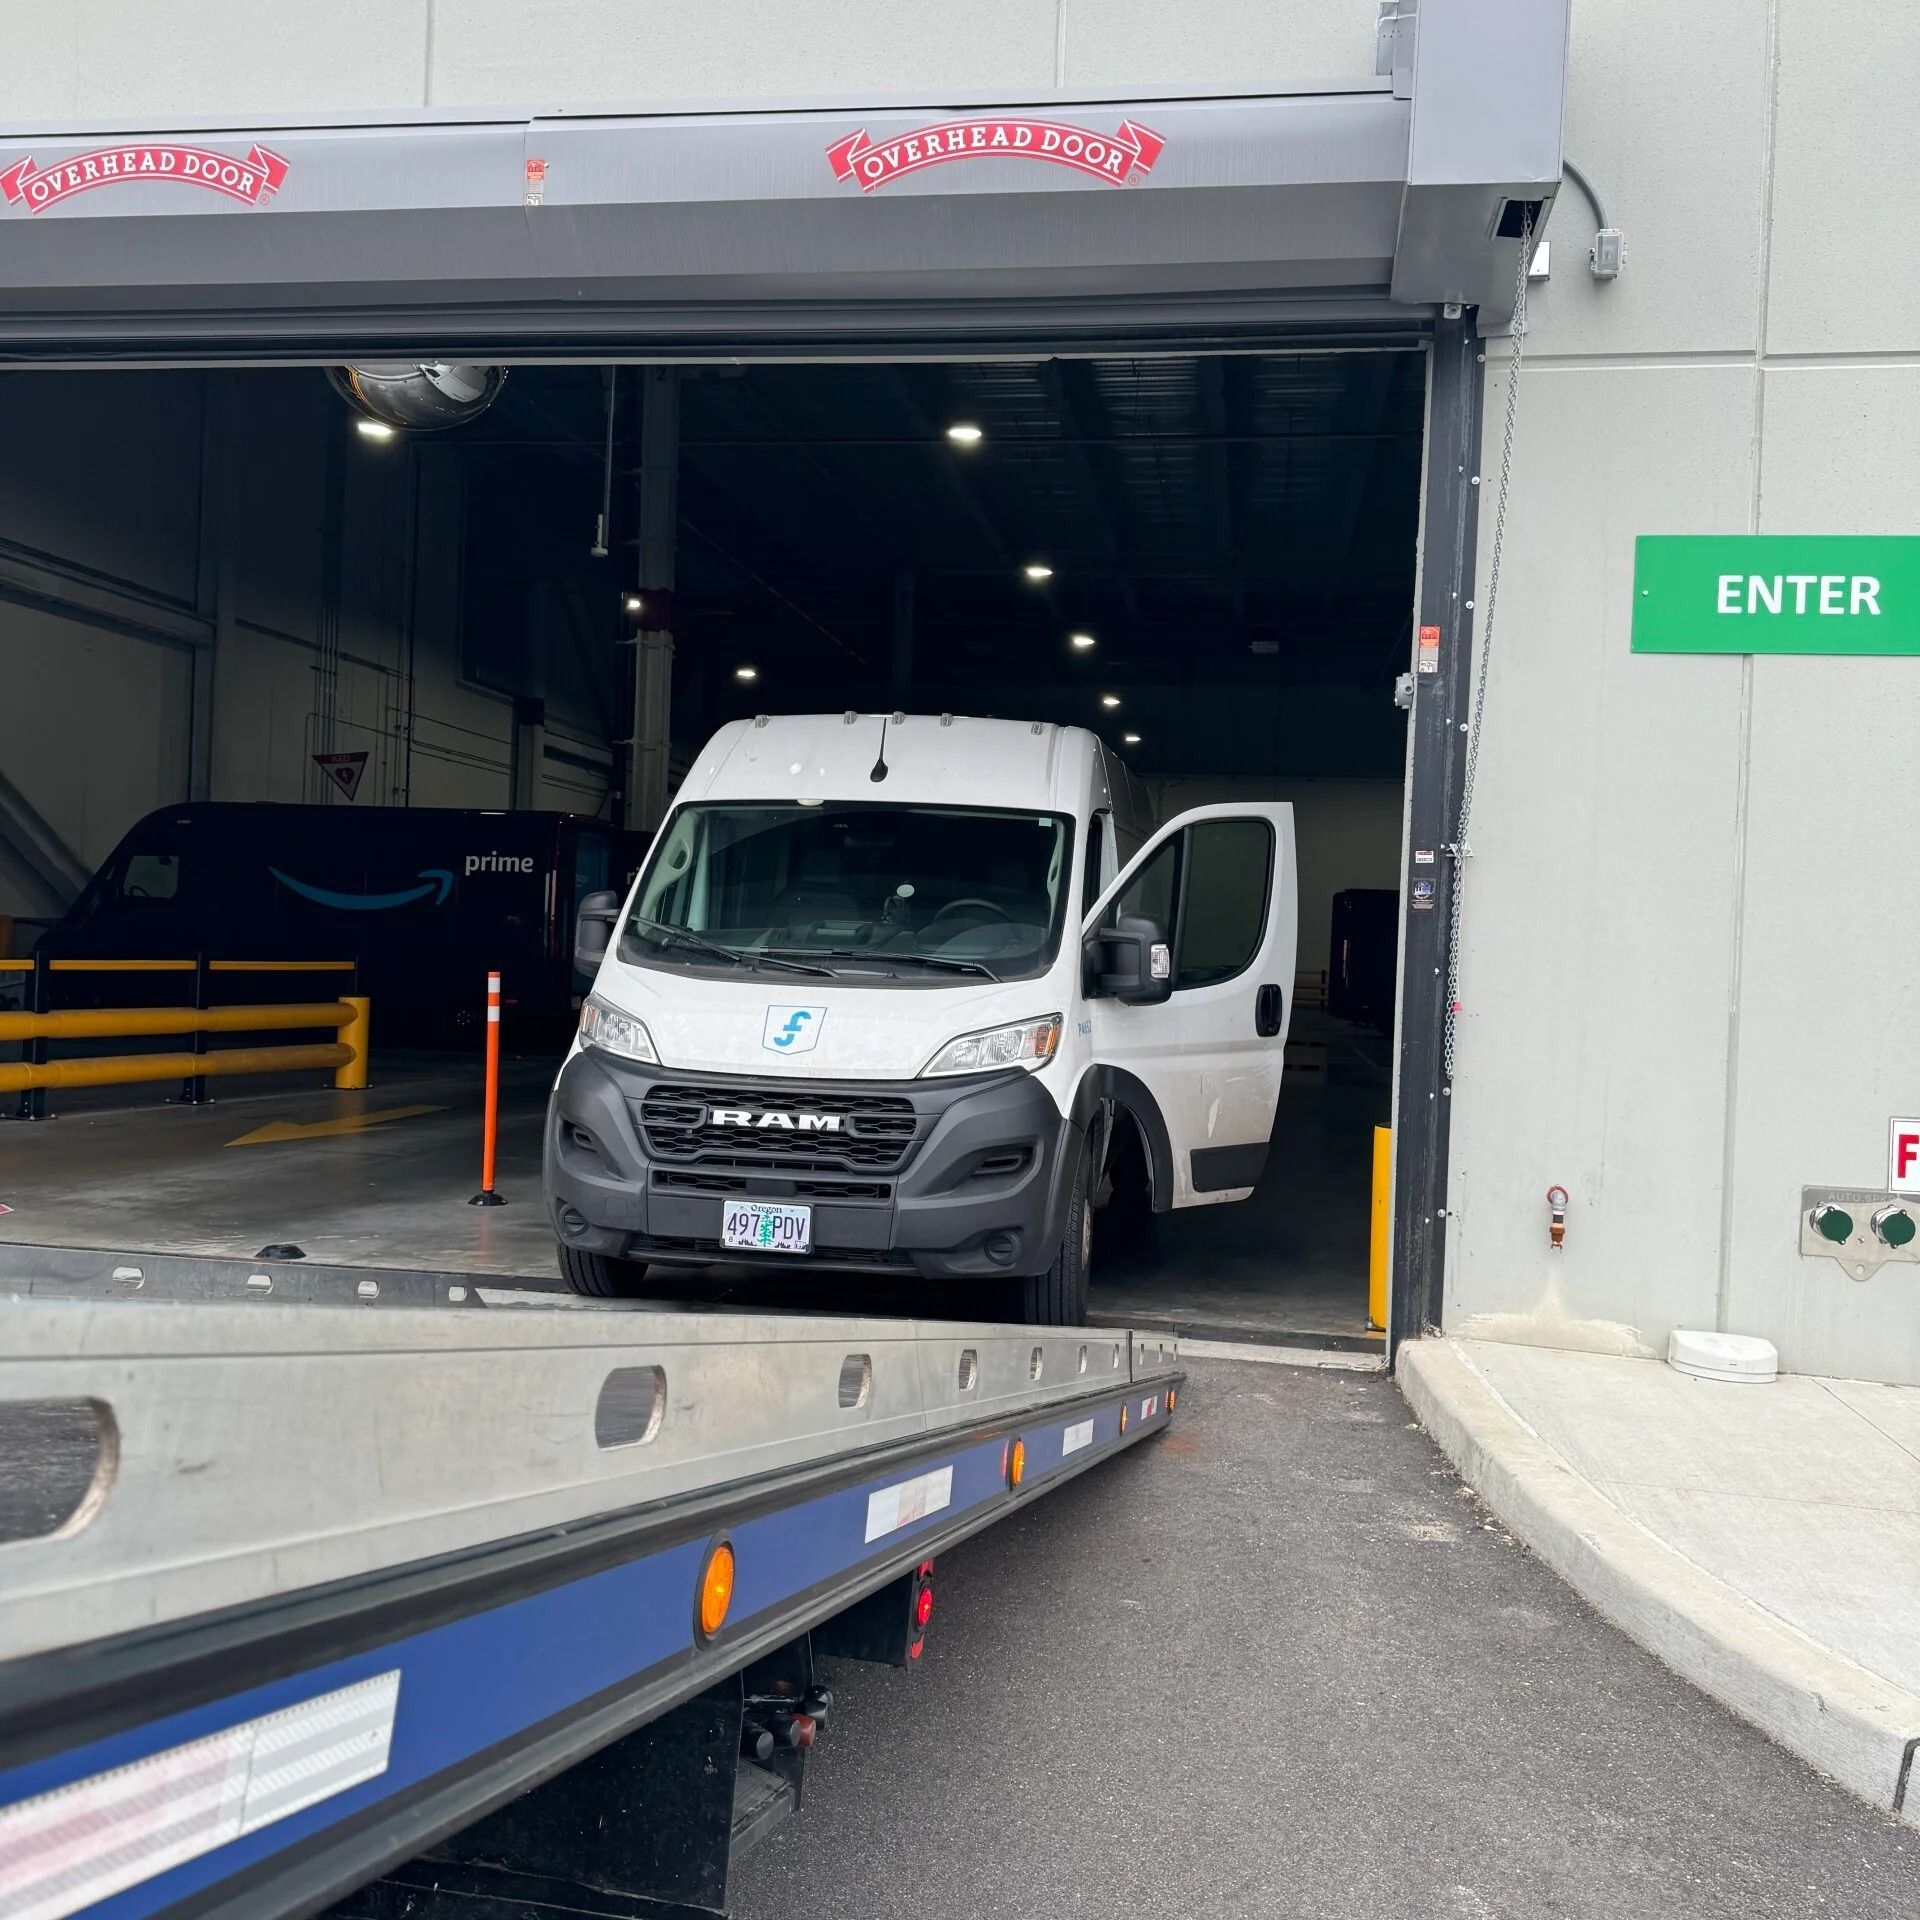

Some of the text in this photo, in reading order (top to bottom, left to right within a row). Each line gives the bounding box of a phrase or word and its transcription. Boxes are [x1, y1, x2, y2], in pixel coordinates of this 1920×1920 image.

[863, 126, 1123, 178] OVERHEAD DOOR
[31, 151, 255, 201] OVERHEAD DOOR
[1717, 575, 1881, 615] ENTER
[465, 850, 534, 876] prime
[712, 1109, 841, 1131] RAM
[1898, 1134, 1920, 1178] F
[727, 1212, 806, 1240] 497 PDV
[750, 1204, 782, 1214] Oregon
